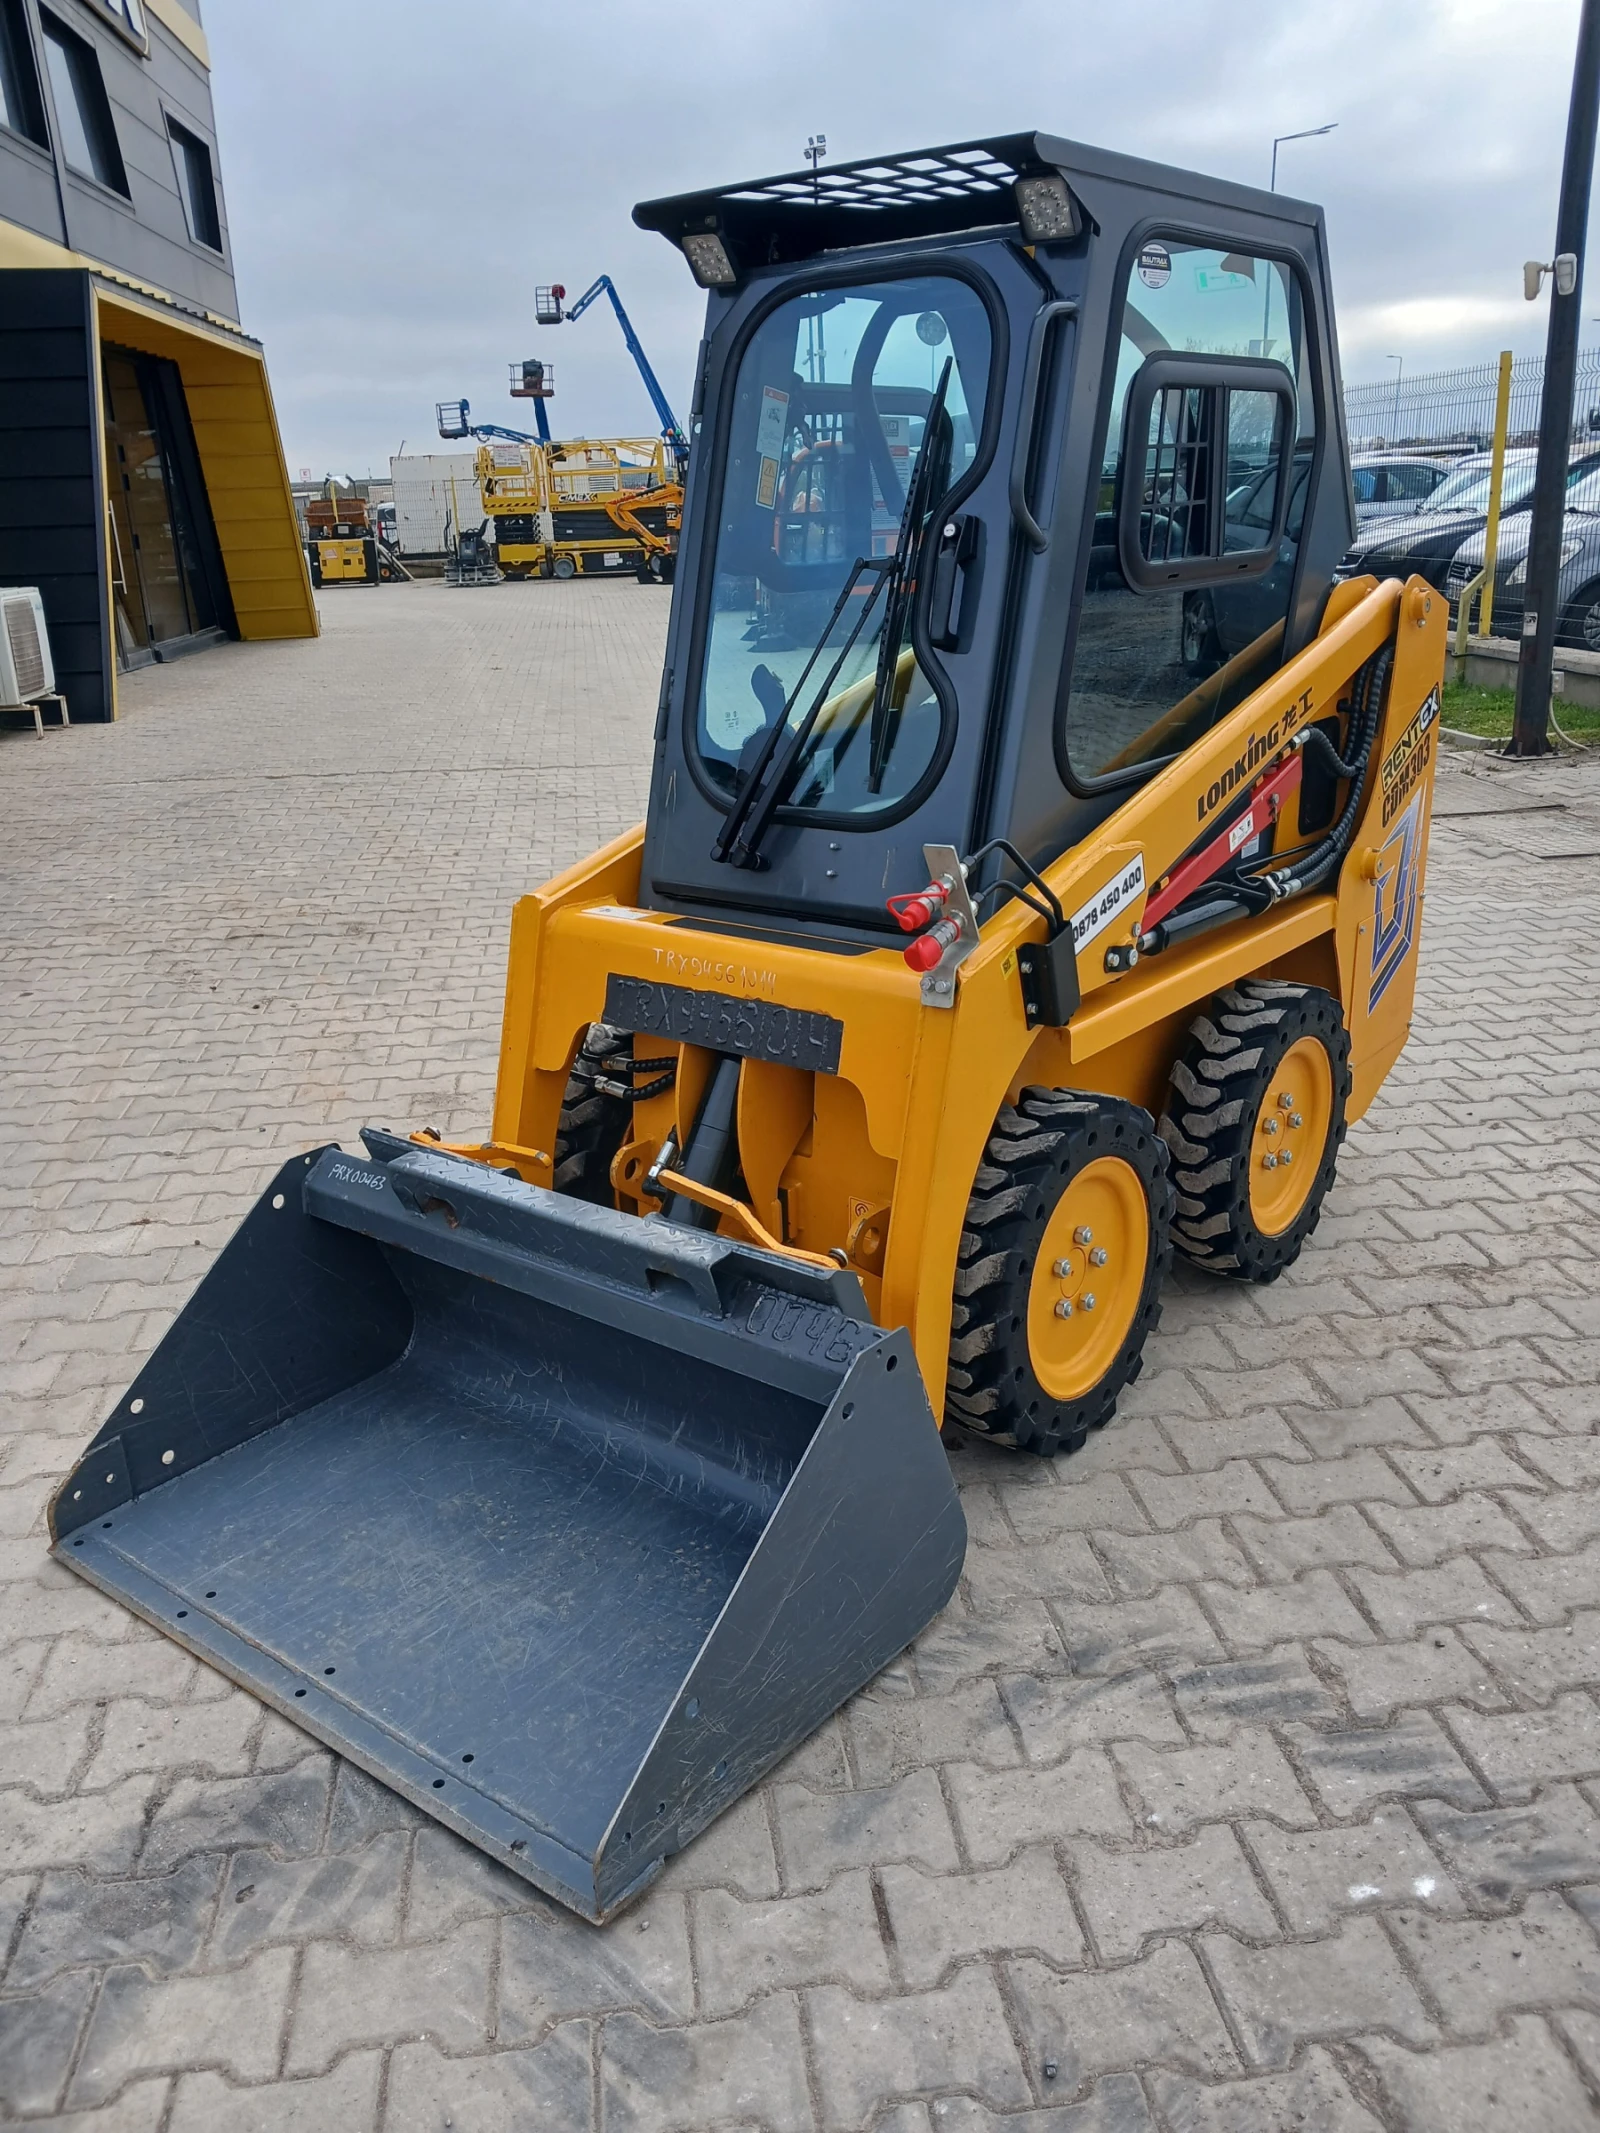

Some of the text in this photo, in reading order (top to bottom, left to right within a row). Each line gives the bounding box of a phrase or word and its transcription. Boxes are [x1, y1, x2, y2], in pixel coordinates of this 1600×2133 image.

[1282, 687, 1314, 736] 龙工
[1382, 688, 1439, 789] RENTEX
[1072, 866, 1142, 943] 0878 450 400
[328, 1164, 387, 1190] PRX00463
